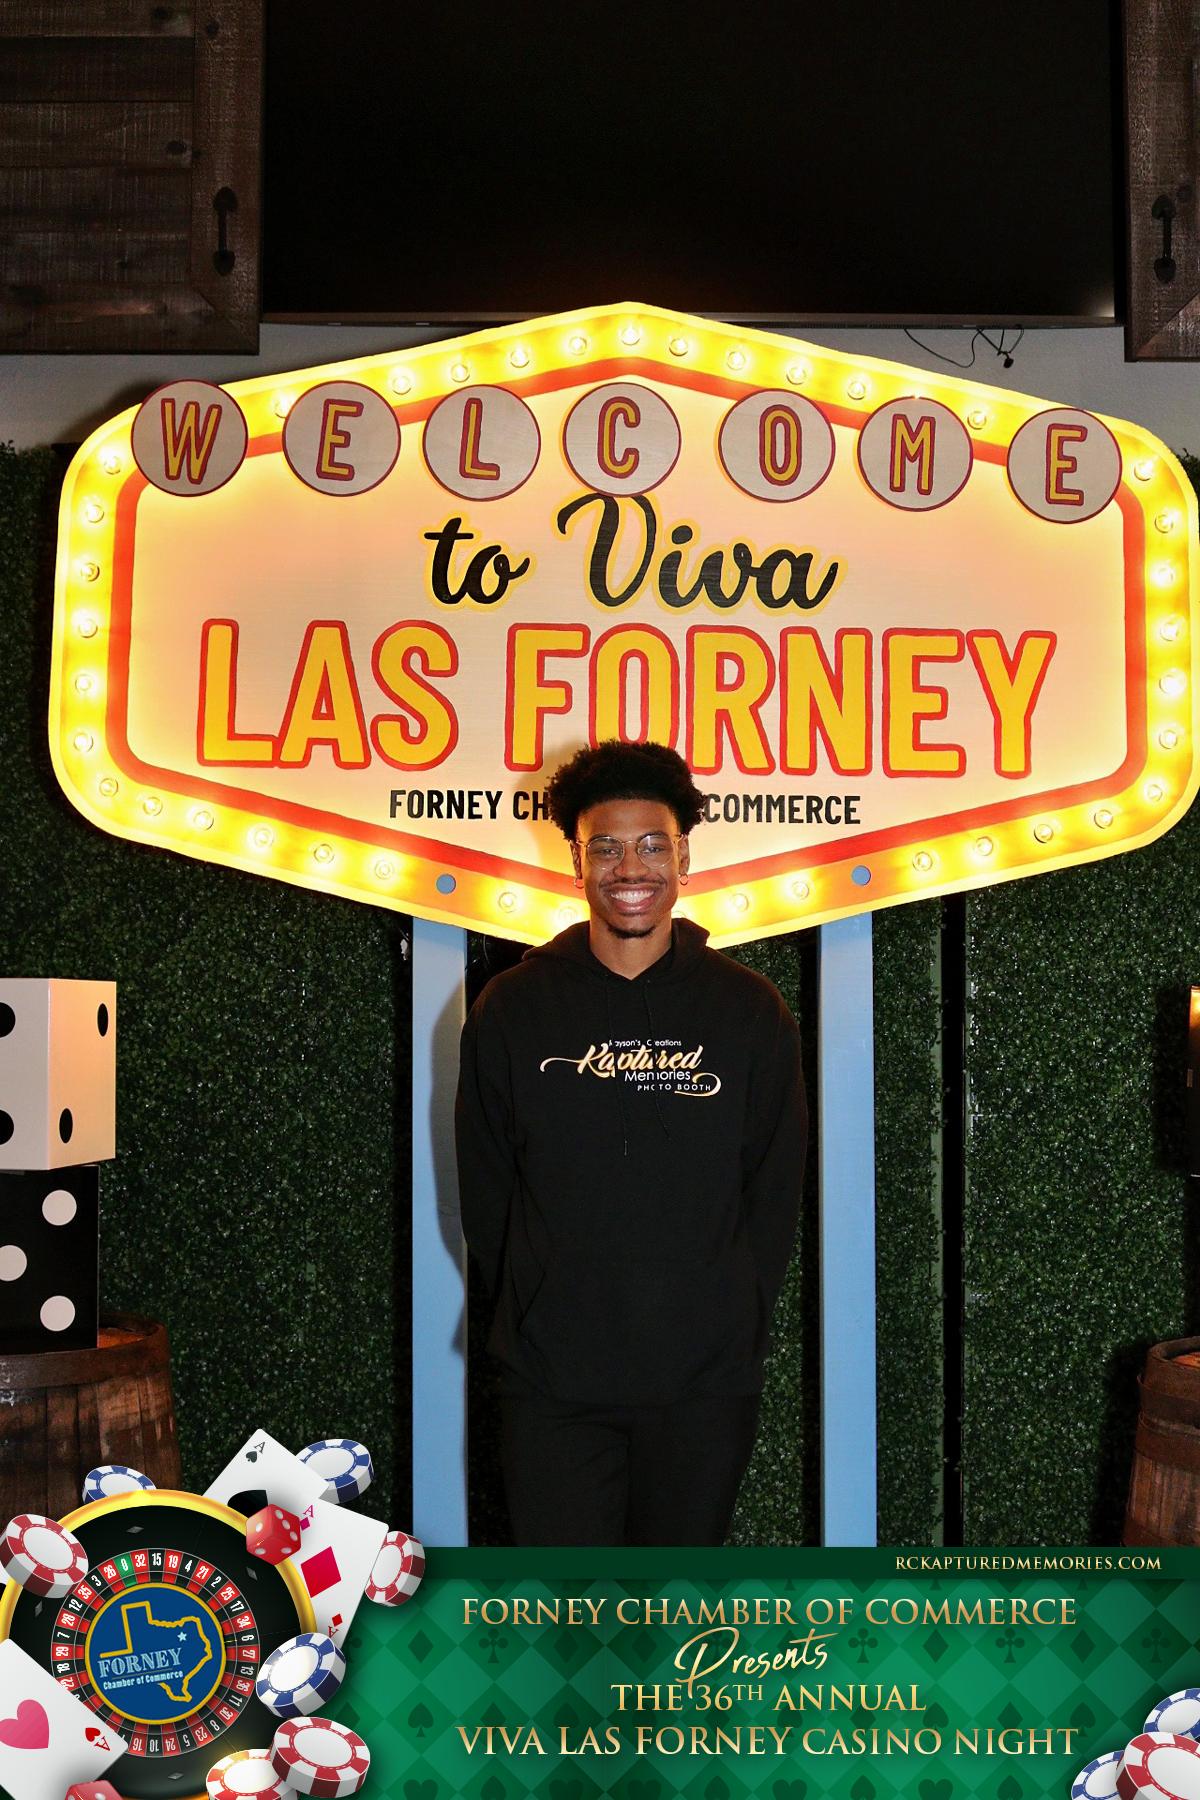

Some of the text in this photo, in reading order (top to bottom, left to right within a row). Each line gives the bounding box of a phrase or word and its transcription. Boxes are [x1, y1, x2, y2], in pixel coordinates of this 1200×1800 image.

[161, 396, 1088, 506] WELCOME
[424, 492, 839, 609] to Viva
[197, 618, 1057, 779] LAS FORNEY
[389, 789, 503, 820] FORNEY
[705, 793, 861, 825] COMMERCE
[540, 1042, 704, 1079] Kaptured
[677, 1083, 712, 1092] BOOTH
